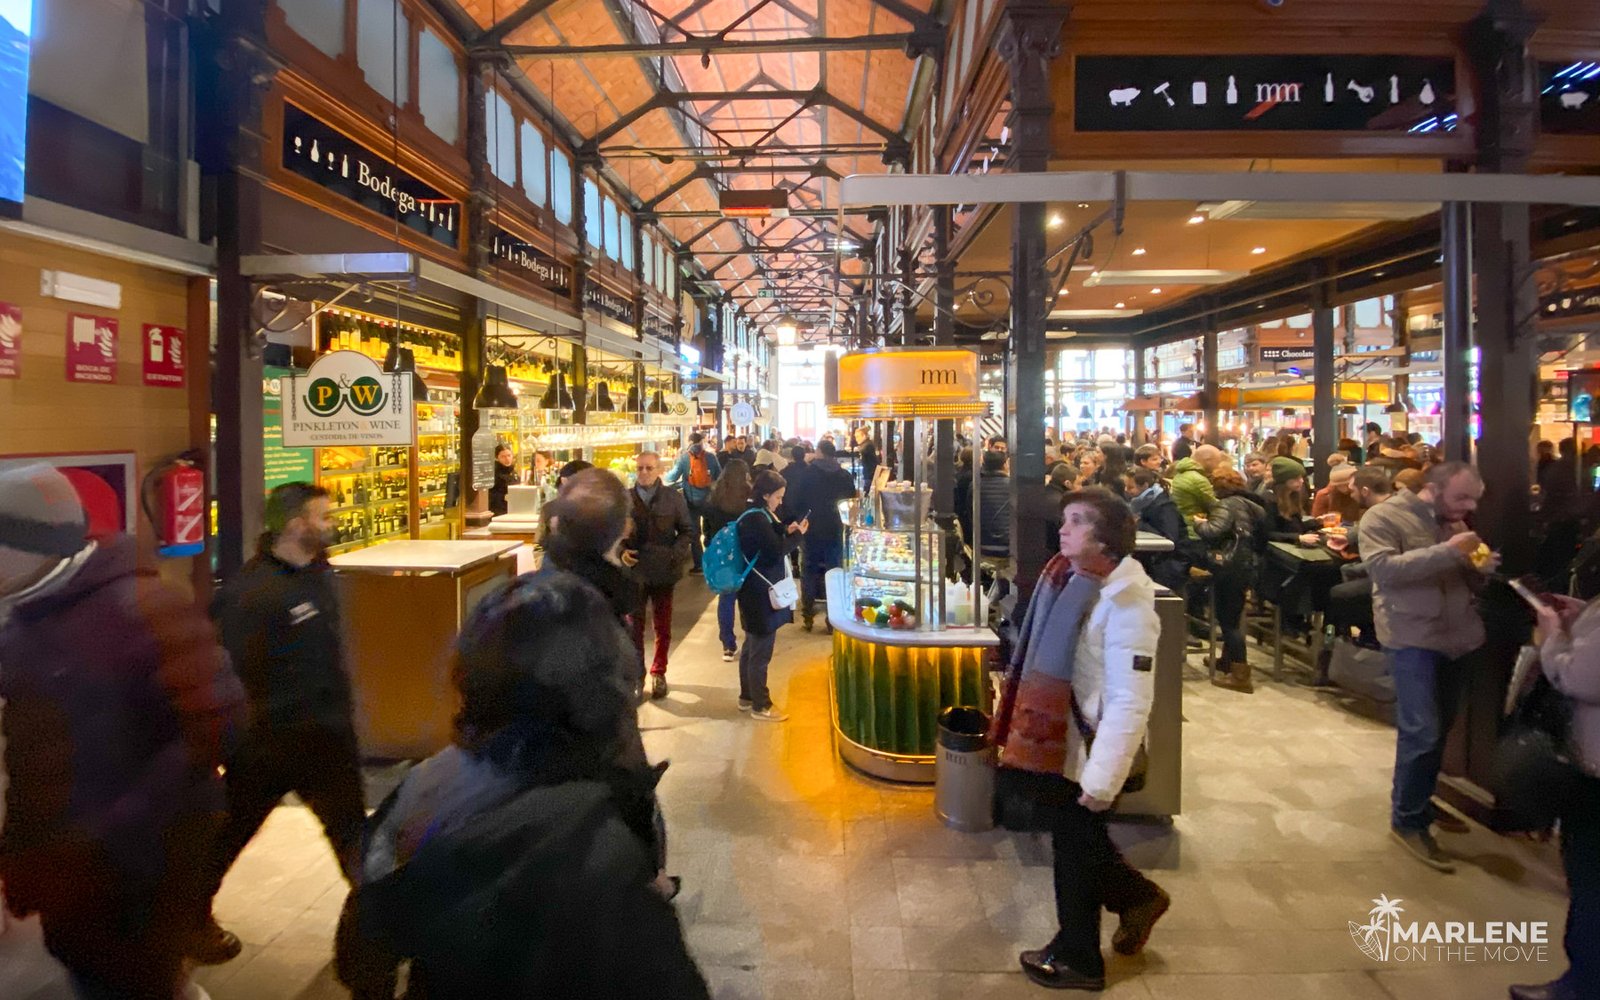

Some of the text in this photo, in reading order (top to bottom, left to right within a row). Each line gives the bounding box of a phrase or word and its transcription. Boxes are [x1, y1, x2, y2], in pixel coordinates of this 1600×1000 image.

[357, 160, 416, 214] Bodega
[520, 250, 549, 281] Bodega
[317, 372, 380, 407] P & W
[292, 421, 360, 432] PINKLETON
[369, 419, 401, 431] WINE
